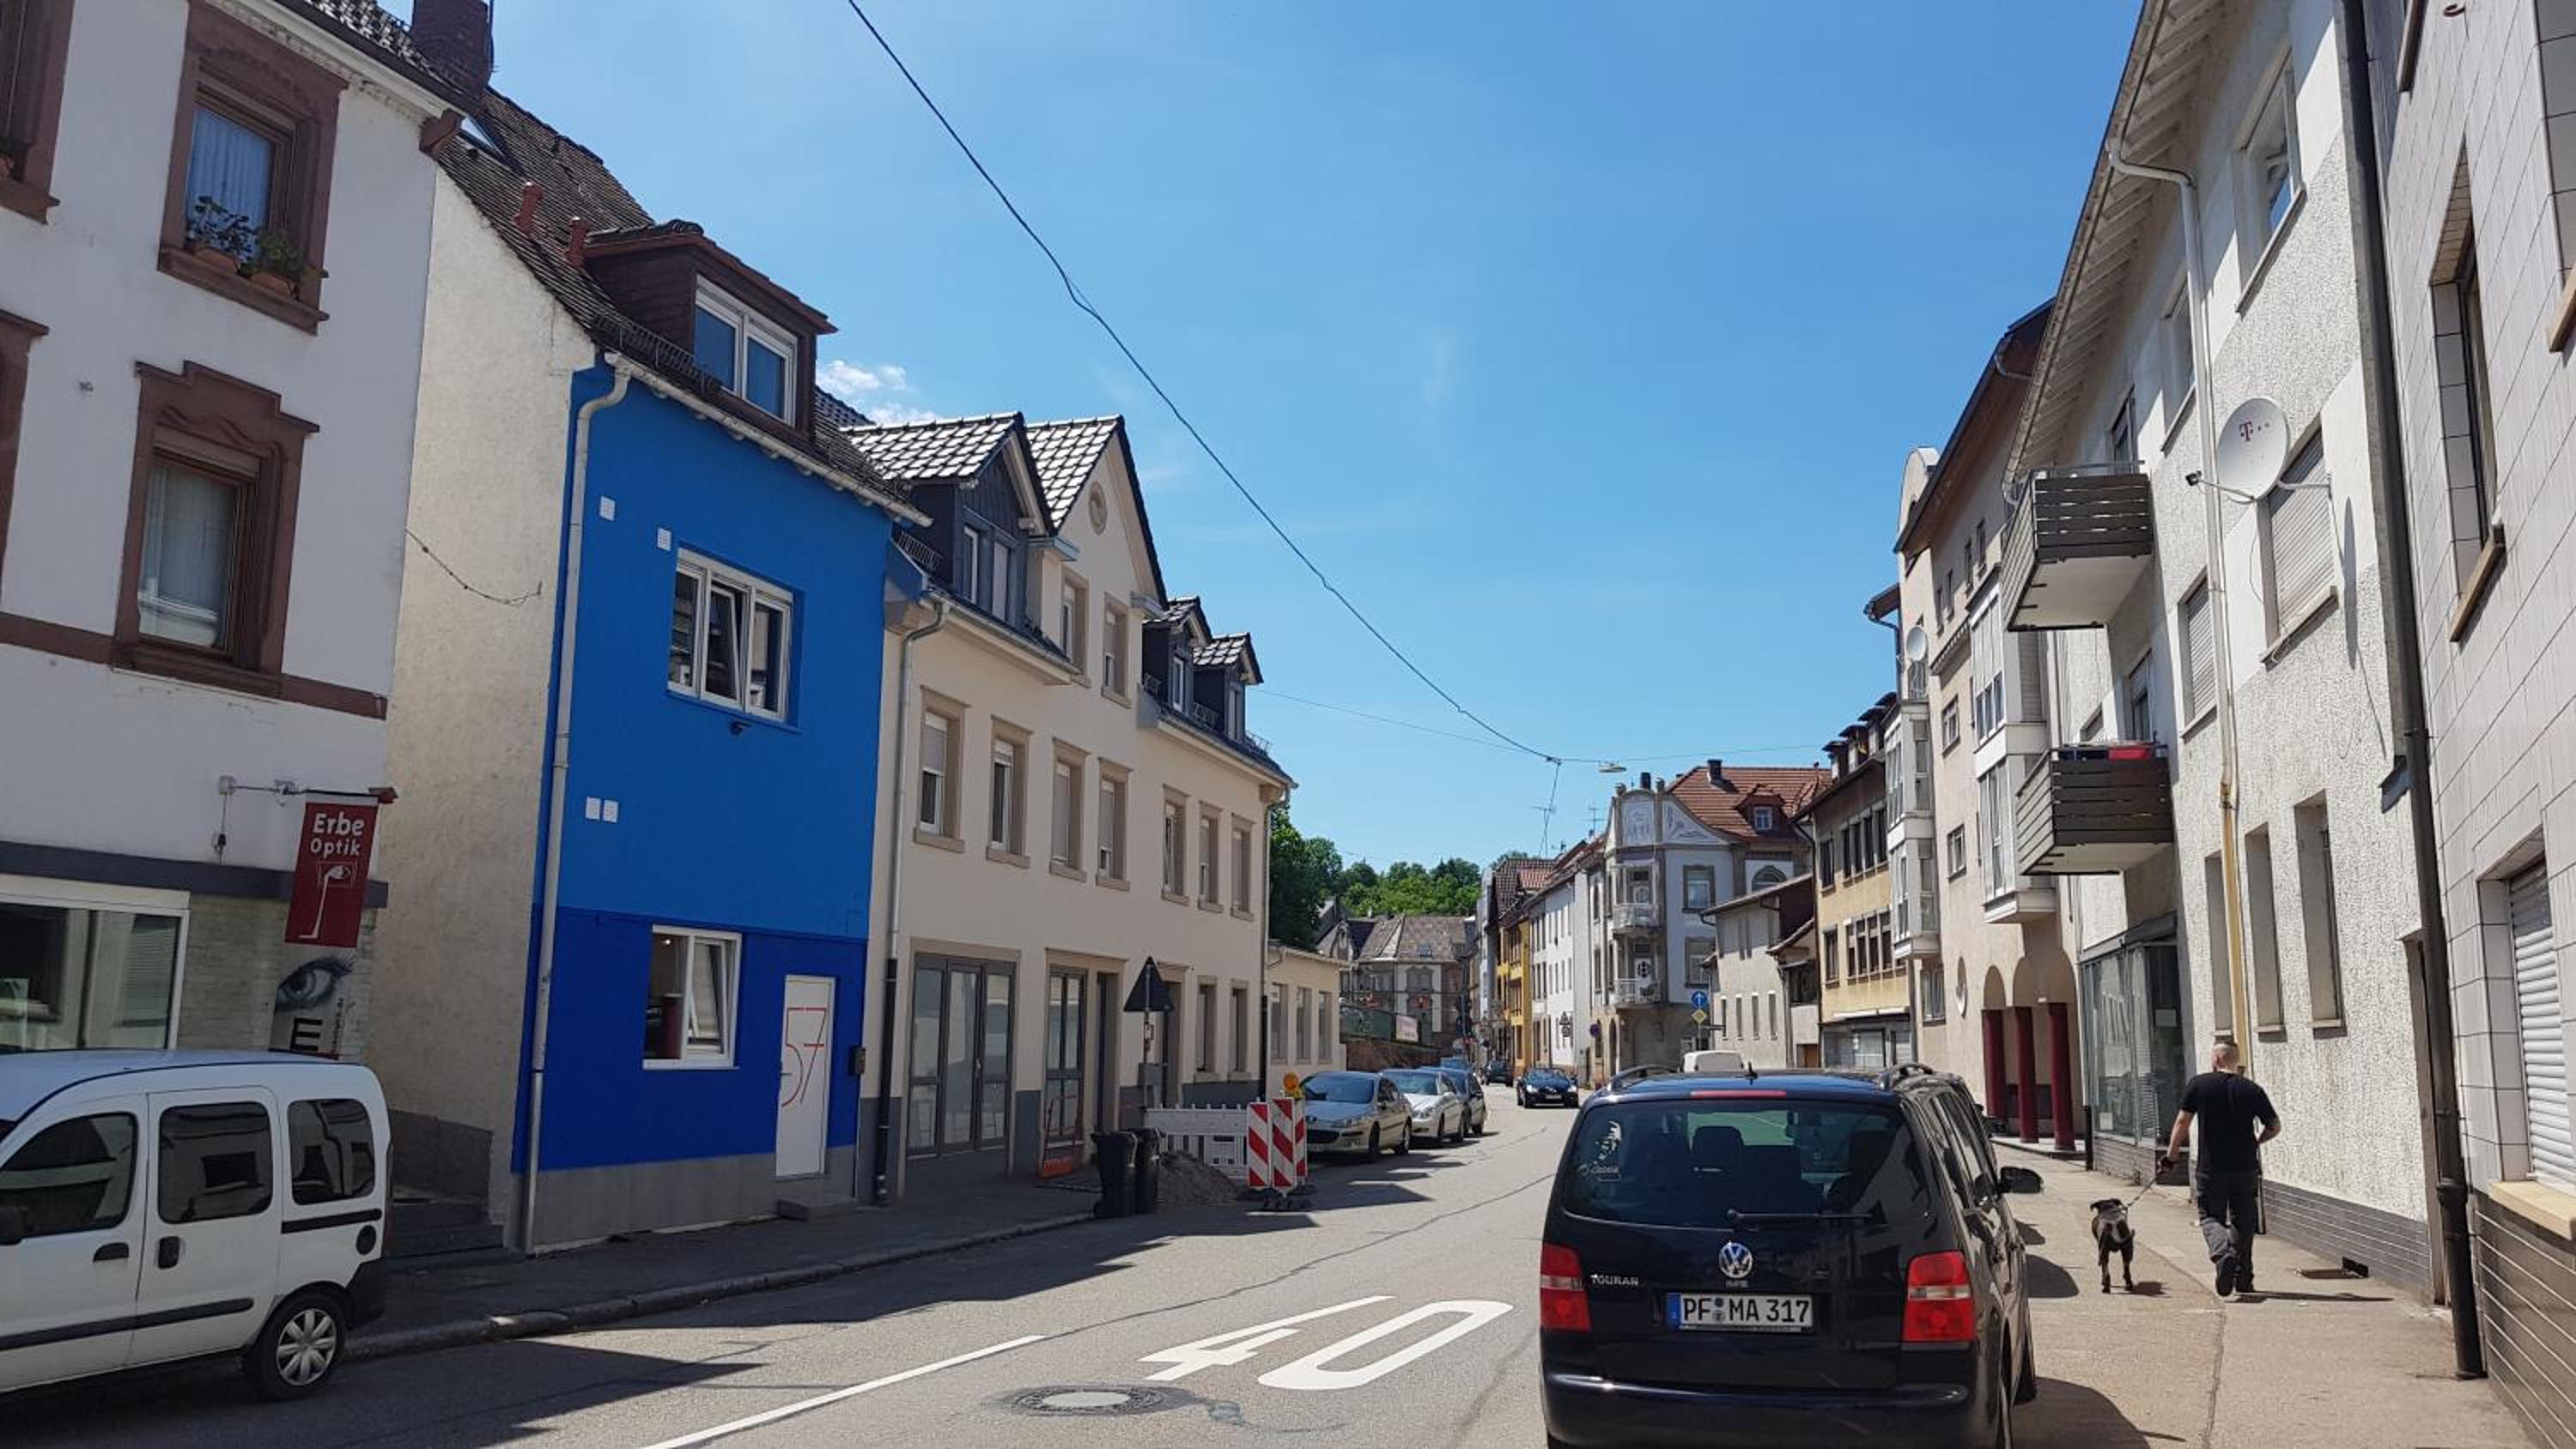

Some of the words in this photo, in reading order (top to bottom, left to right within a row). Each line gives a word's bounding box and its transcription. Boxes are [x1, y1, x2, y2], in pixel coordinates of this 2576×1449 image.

[313, 811, 364, 836] Erbe
[310, 838, 361, 858] Optik
[781, 1007, 826, 1107] 57
[1590, 1273, 1639, 1286] TOURAN
[1683, 1297, 1711, 1320] PF
[1728, 1298, 1759, 1321] MA
[1765, 1299, 1809, 1323] 317
[1137, 1295, 1514, 1390] 40
